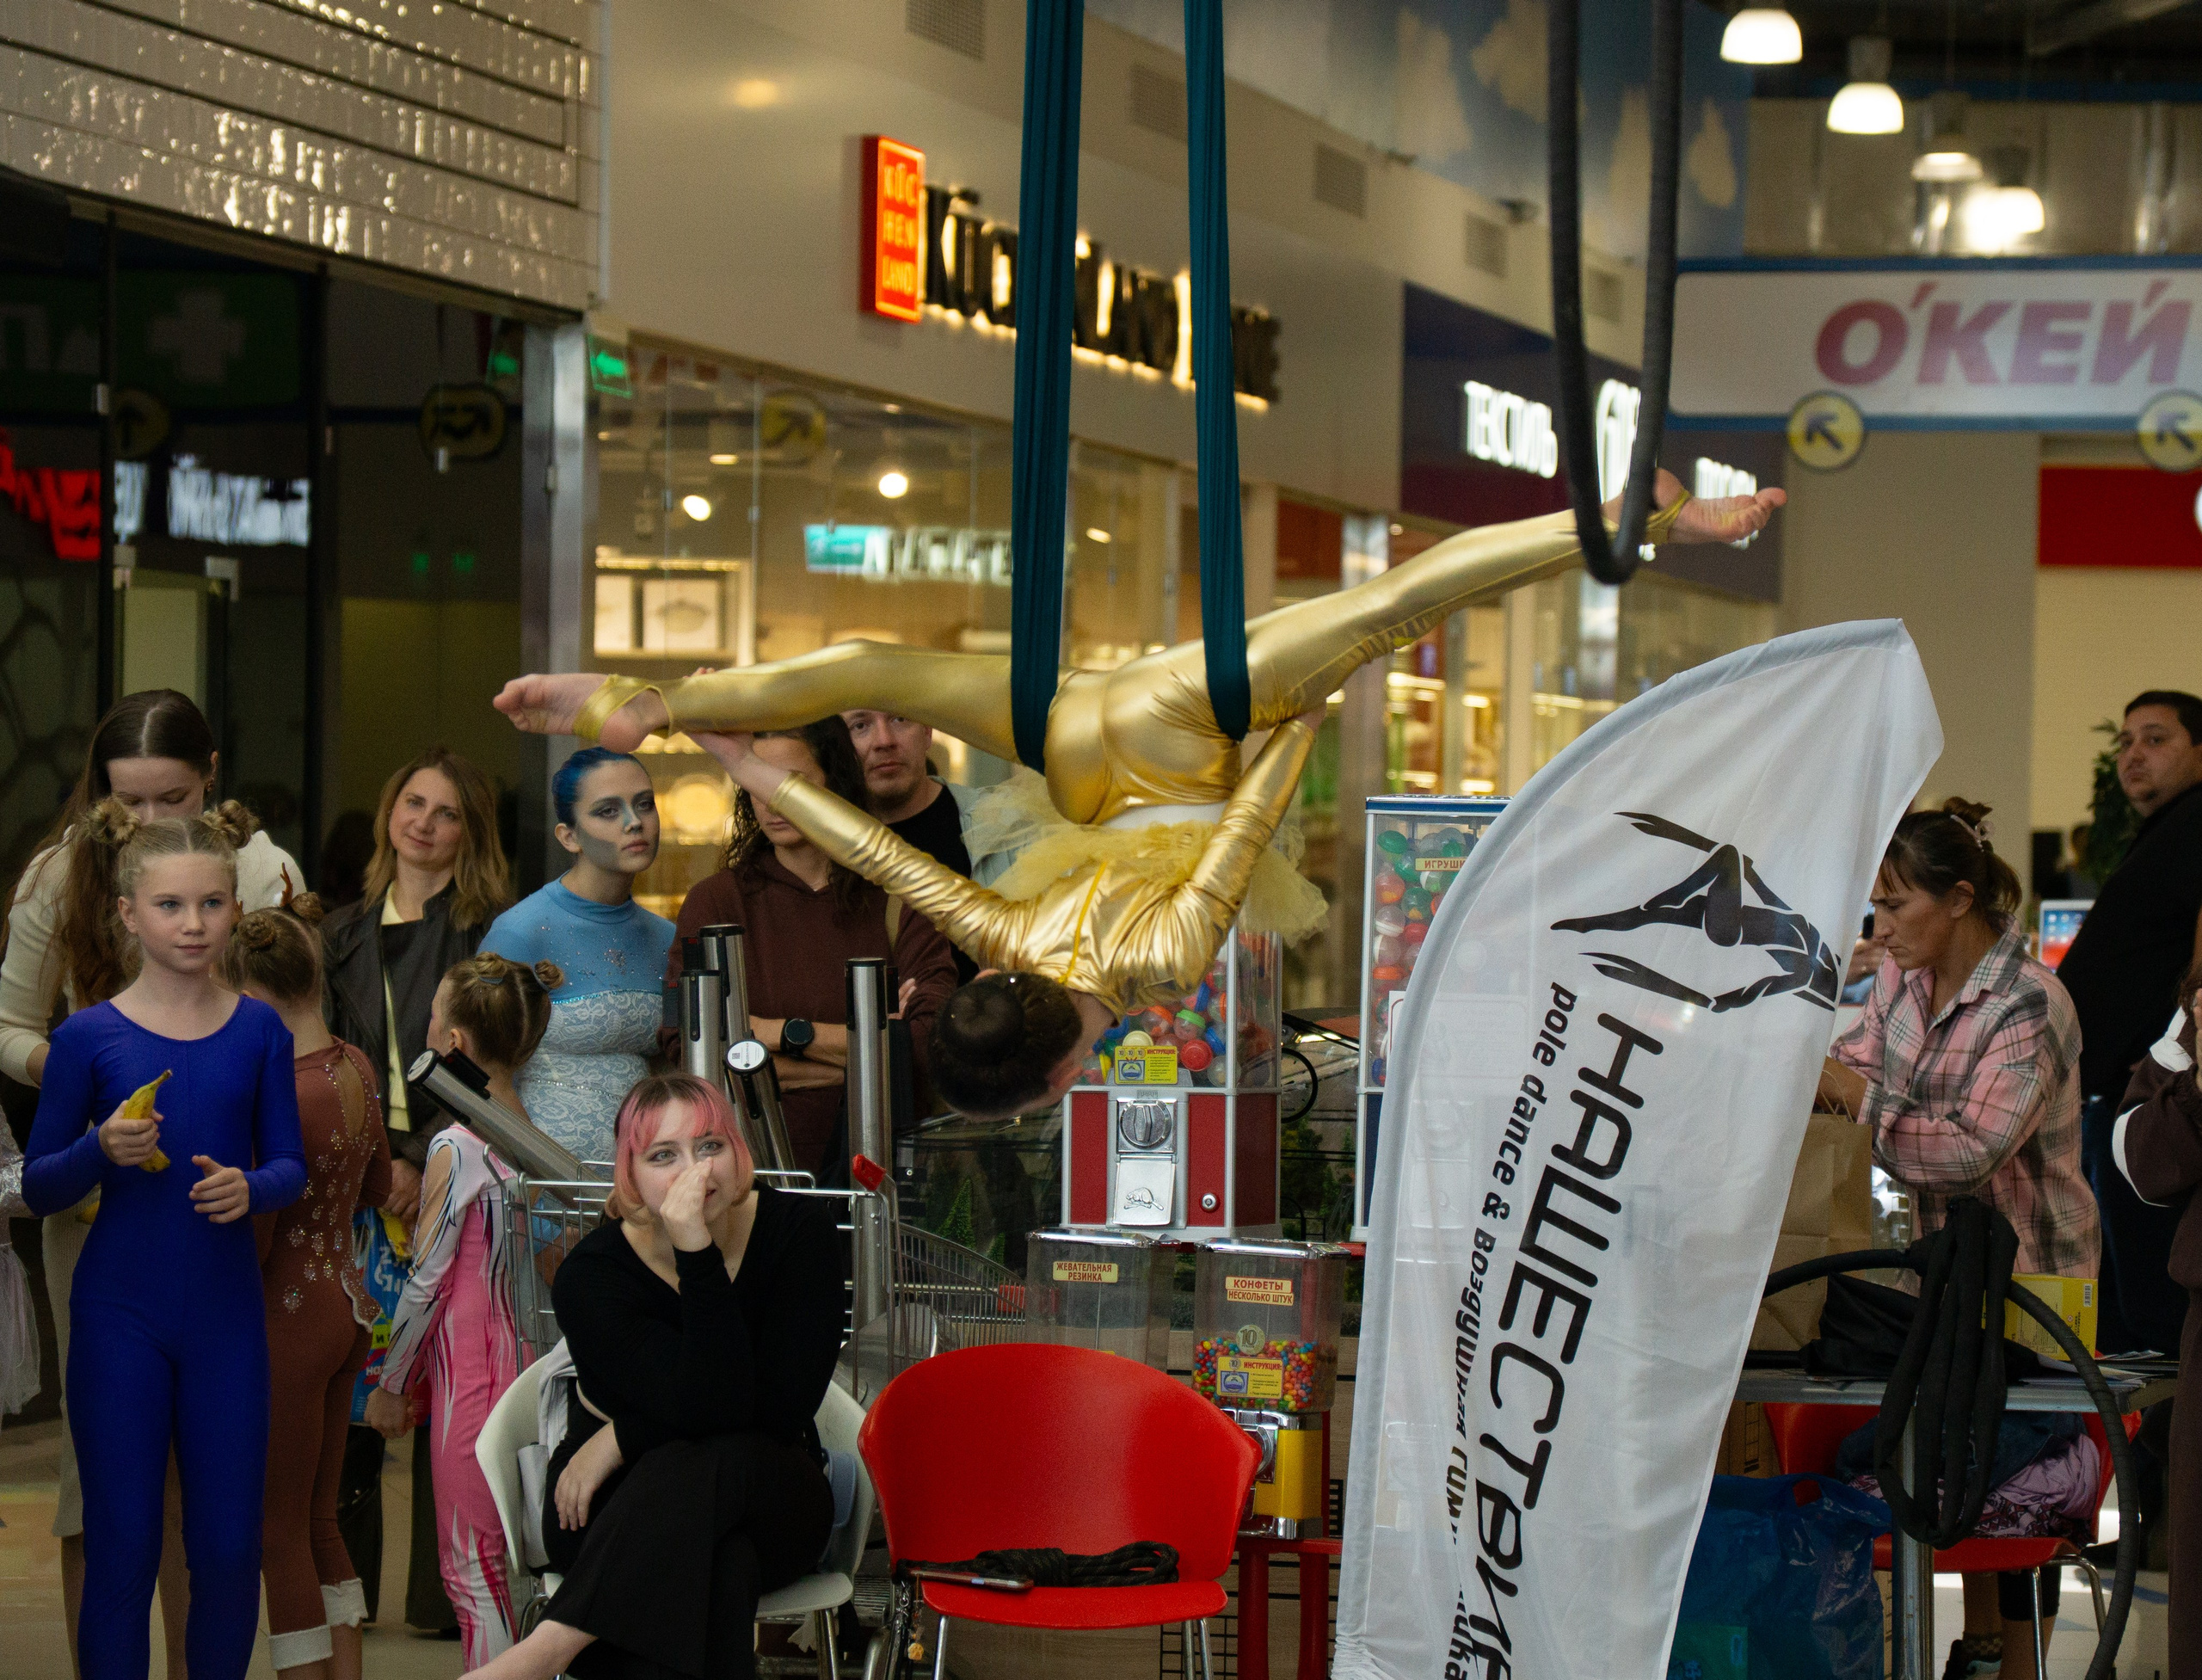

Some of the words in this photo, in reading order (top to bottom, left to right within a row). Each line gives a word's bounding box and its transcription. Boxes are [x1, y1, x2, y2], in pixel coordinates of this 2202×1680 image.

[1424, 859, 1466, 869] ИГРУШК
[1532, 982, 1578, 1067] pole
[1492, 1074, 1547, 1186] dance
[1481, 1191, 1510, 1221] &
[1056, 1262, 1112, 1272] ЖЕВАТЕЛЬНАЯ
[1067, 1272, 1102, 1281] РЕЗИНКА
[1233, 1279, 1283, 1290] КОНФЕТЫ
[1228, 1291, 1270, 1302] НЕСКОЛЬКО
[1272, 1295, 1293, 1304] ШТУК
[1240, 1329, 1258, 1345] 10
